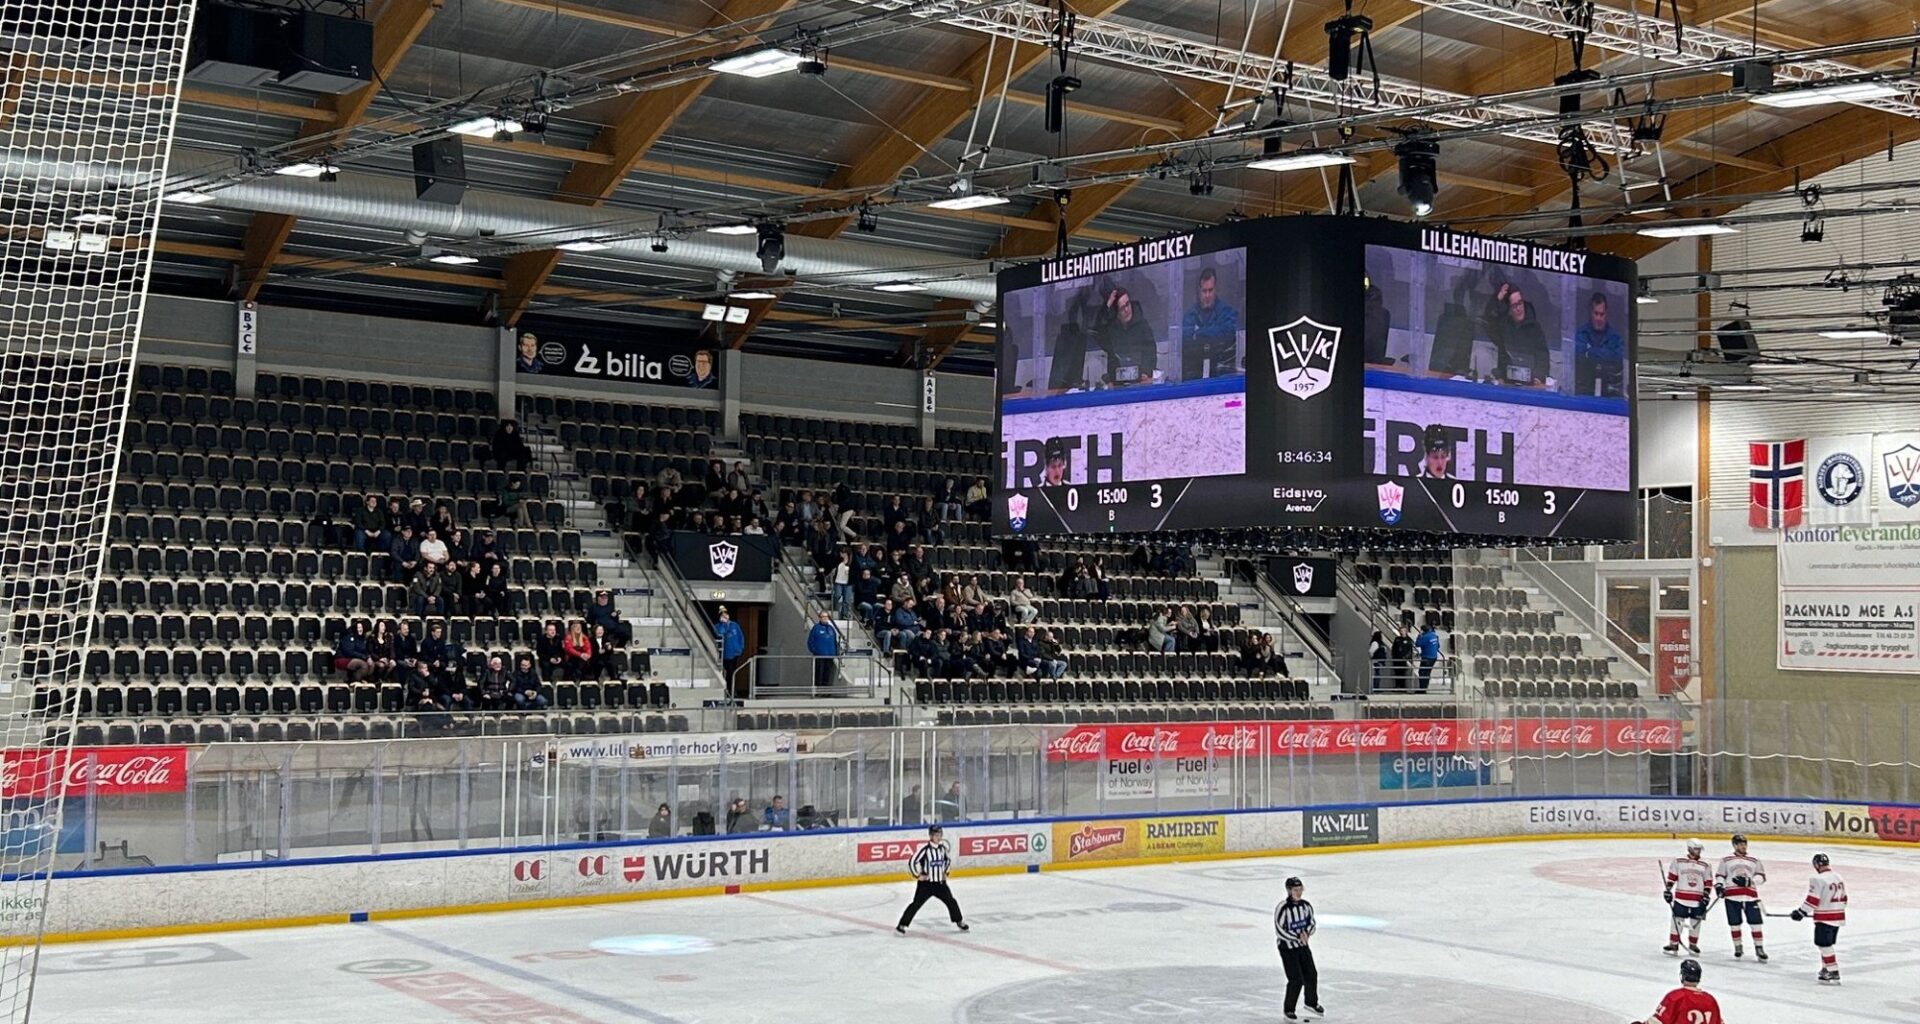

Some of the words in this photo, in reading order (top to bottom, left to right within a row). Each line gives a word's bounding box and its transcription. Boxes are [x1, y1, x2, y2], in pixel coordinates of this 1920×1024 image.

[1421, 229, 1527, 265] LILLEHAMMER
[1533, 247, 1587, 274] HOCKEY
[1041, 246, 1134, 283] LILLEHAMMER
[1139, 234, 1194, 264] HOCKEY
[244, 312, 252, 322] B
[243, 333, 252, 344] C
[606, 351, 662, 380] bilia
[927, 378, 933, 387] A
[1294, 382, 1315, 392] 1957
[926, 396, 932, 405] B
[1276, 451, 1332, 463] 18:46:34
[1067, 488, 1078, 511] 0
[1096, 487, 1128, 504] 15:00
[1150, 484, 1162, 508] 3
[1451, 483, 1465, 508] 0
[1485, 488, 1519, 506] 15:00
[1543, 490, 1556, 514] 3
[1285, 504, 1312, 512] Arena
[1108, 510, 1115, 521] B
[1498, 512, 1505, 523] B
[1784, 604, 1850, 617] RAGNVALD
[1859, 605, 1885, 617] MOE
[1109, 758, 1141, 774] Fuel
[1176, 757, 1207, 772] Fuel
[1109, 778, 1118, 788] of
[1121, 777, 1153, 788] Norway
[1176, 776, 1185, 786] of
[1147, 821, 1219, 839] RAMIRENT
[972, 837, 1027, 853] SPAR
[1071, 832, 1122, 854] Stabburet
